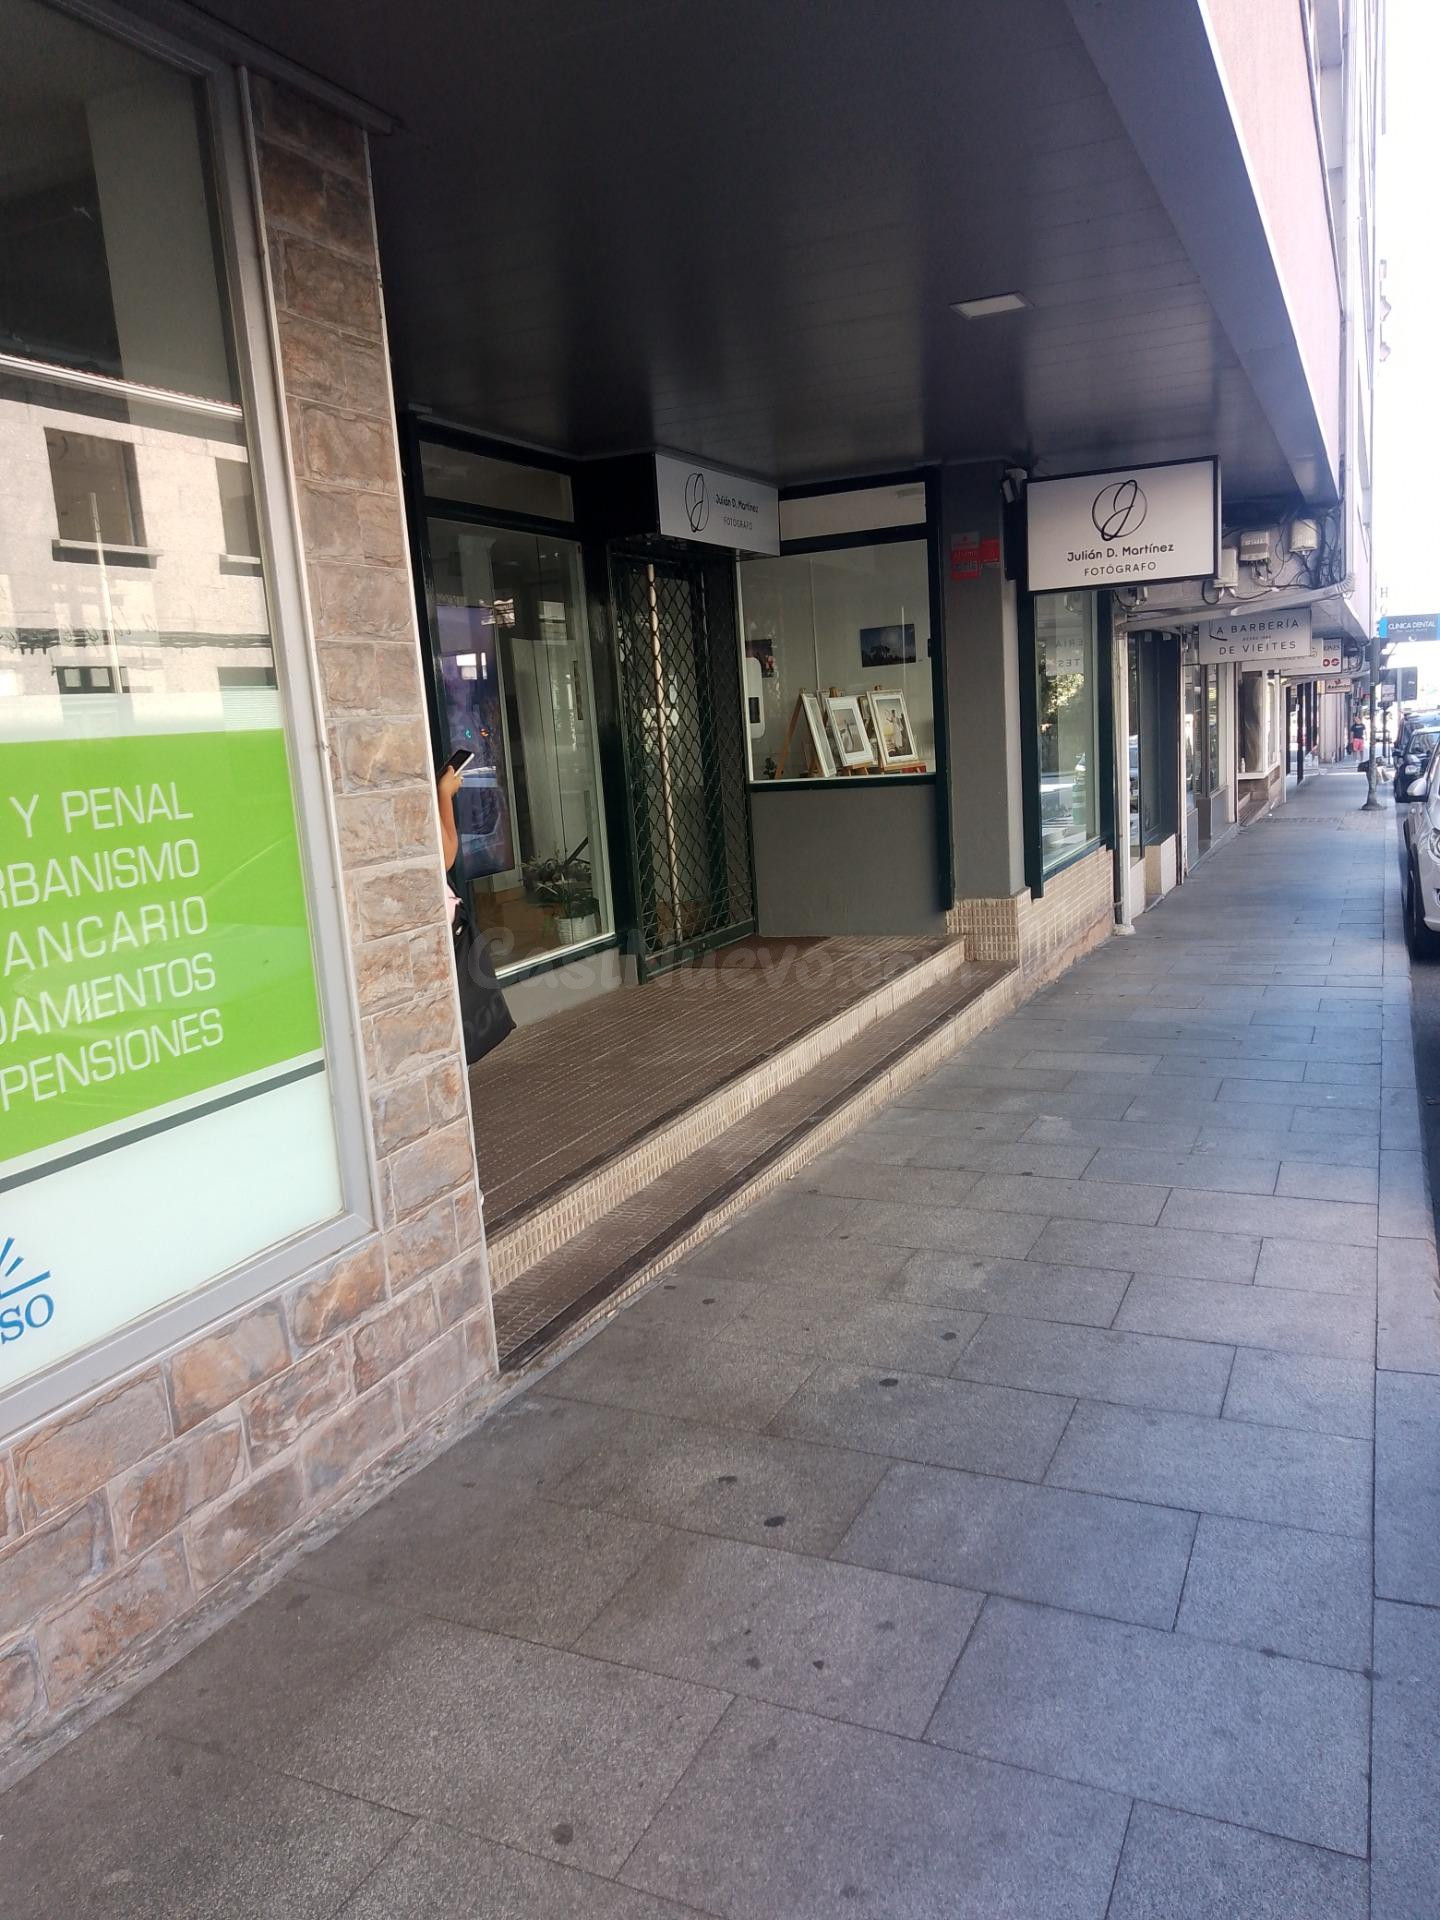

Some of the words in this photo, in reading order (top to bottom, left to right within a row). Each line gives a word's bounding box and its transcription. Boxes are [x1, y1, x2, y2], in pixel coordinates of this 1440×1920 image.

[1067, 549, 1103, 562] Julián
[1107, 547, 1118, 558] D.
[1122, 543, 1174, 556] Martínez
[1084, 562, 1157, 577] FOTÓGRAFO
[1231, 617, 1299, 633] BARBERÍA
[1219, 645, 1236, 656] DE
[9, 793, 40, 839] Y
[61, 781, 194, 834] PENAL
[0, 838, 200, 909] BANISMO
[0, 1008, 225, 1112] PENSIONES
